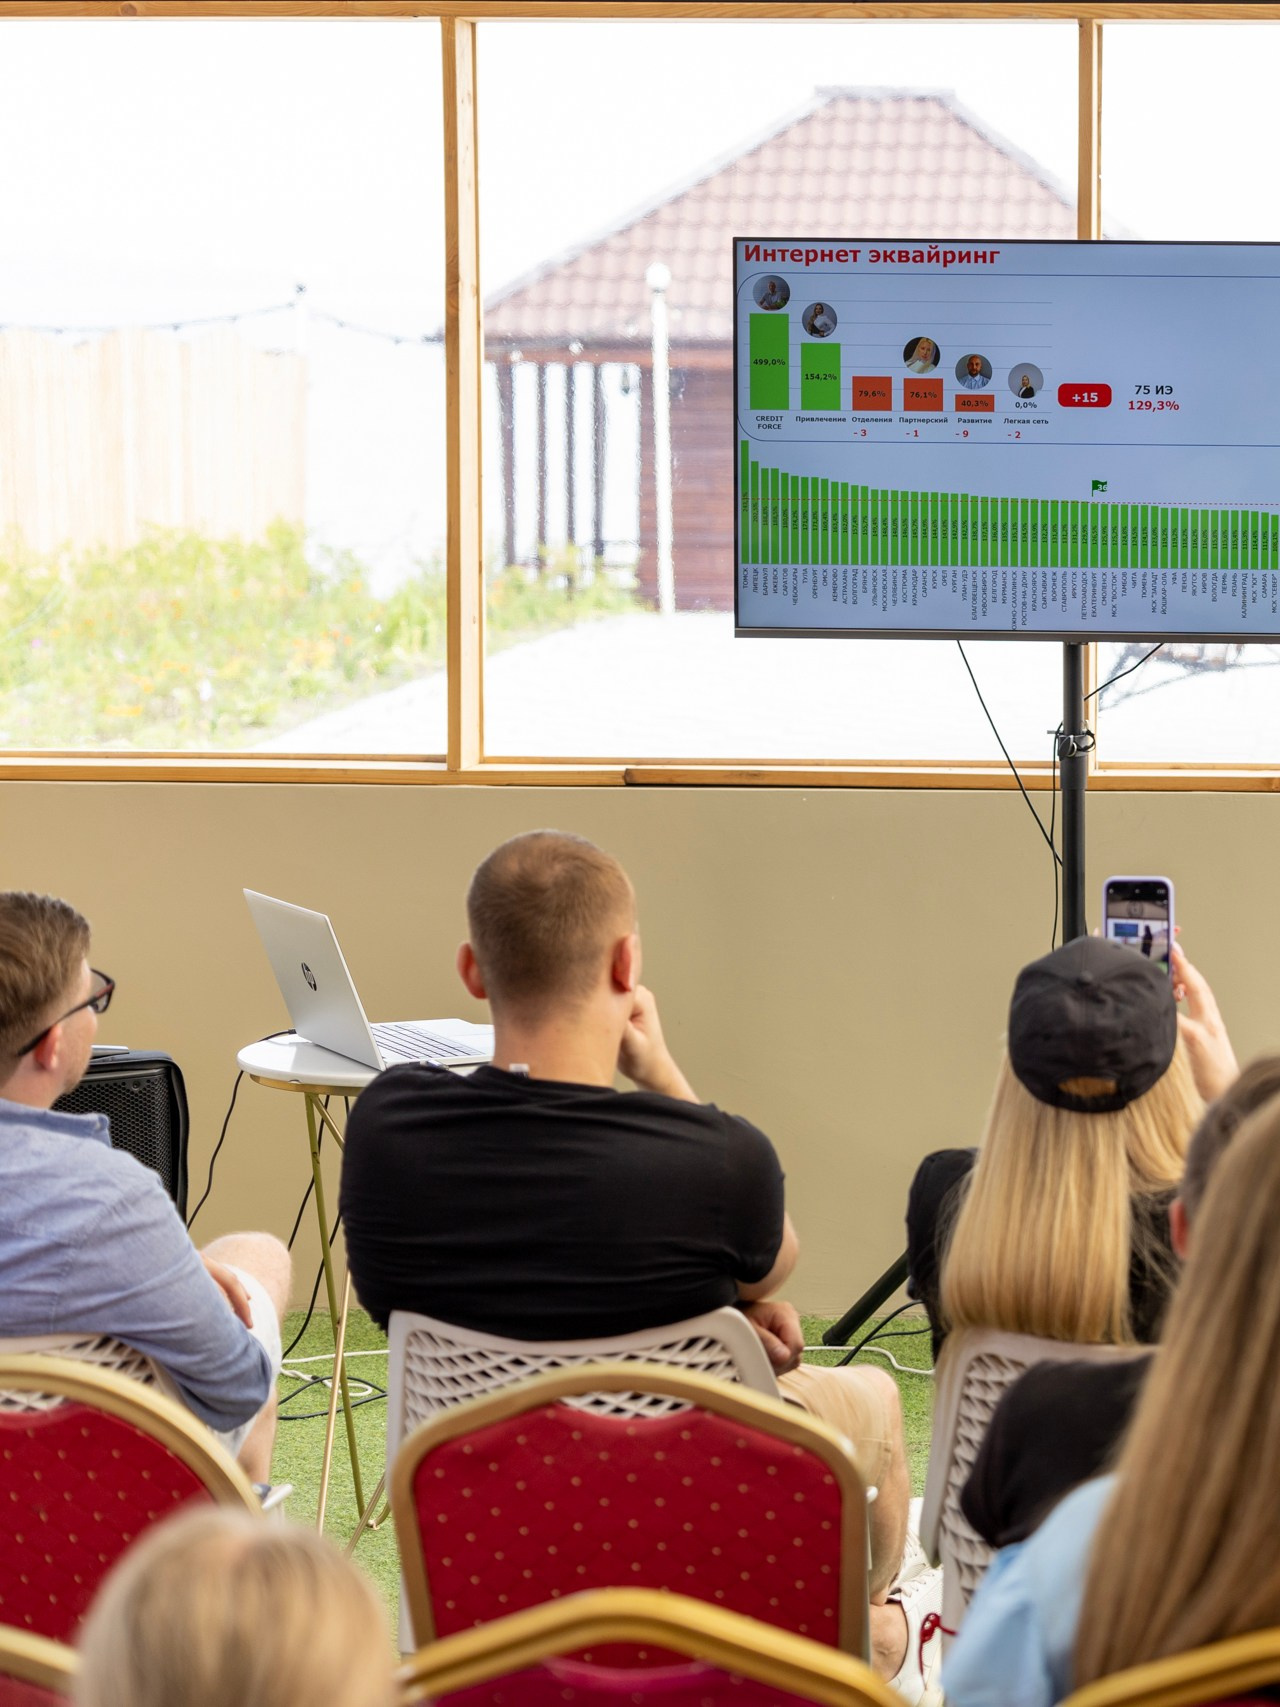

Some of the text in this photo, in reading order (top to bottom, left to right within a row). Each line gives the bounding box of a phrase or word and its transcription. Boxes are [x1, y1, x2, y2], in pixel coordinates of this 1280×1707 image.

[744, 244, 1000, 267] Интернет эквайринг
[858, 390, 886, 398] 79,6%
[1135, 385, 1173, 395] 75 ИЭ
[1072, 393, 1098, 402] +15
[1128, 401, 1179, 412] 129,3%
